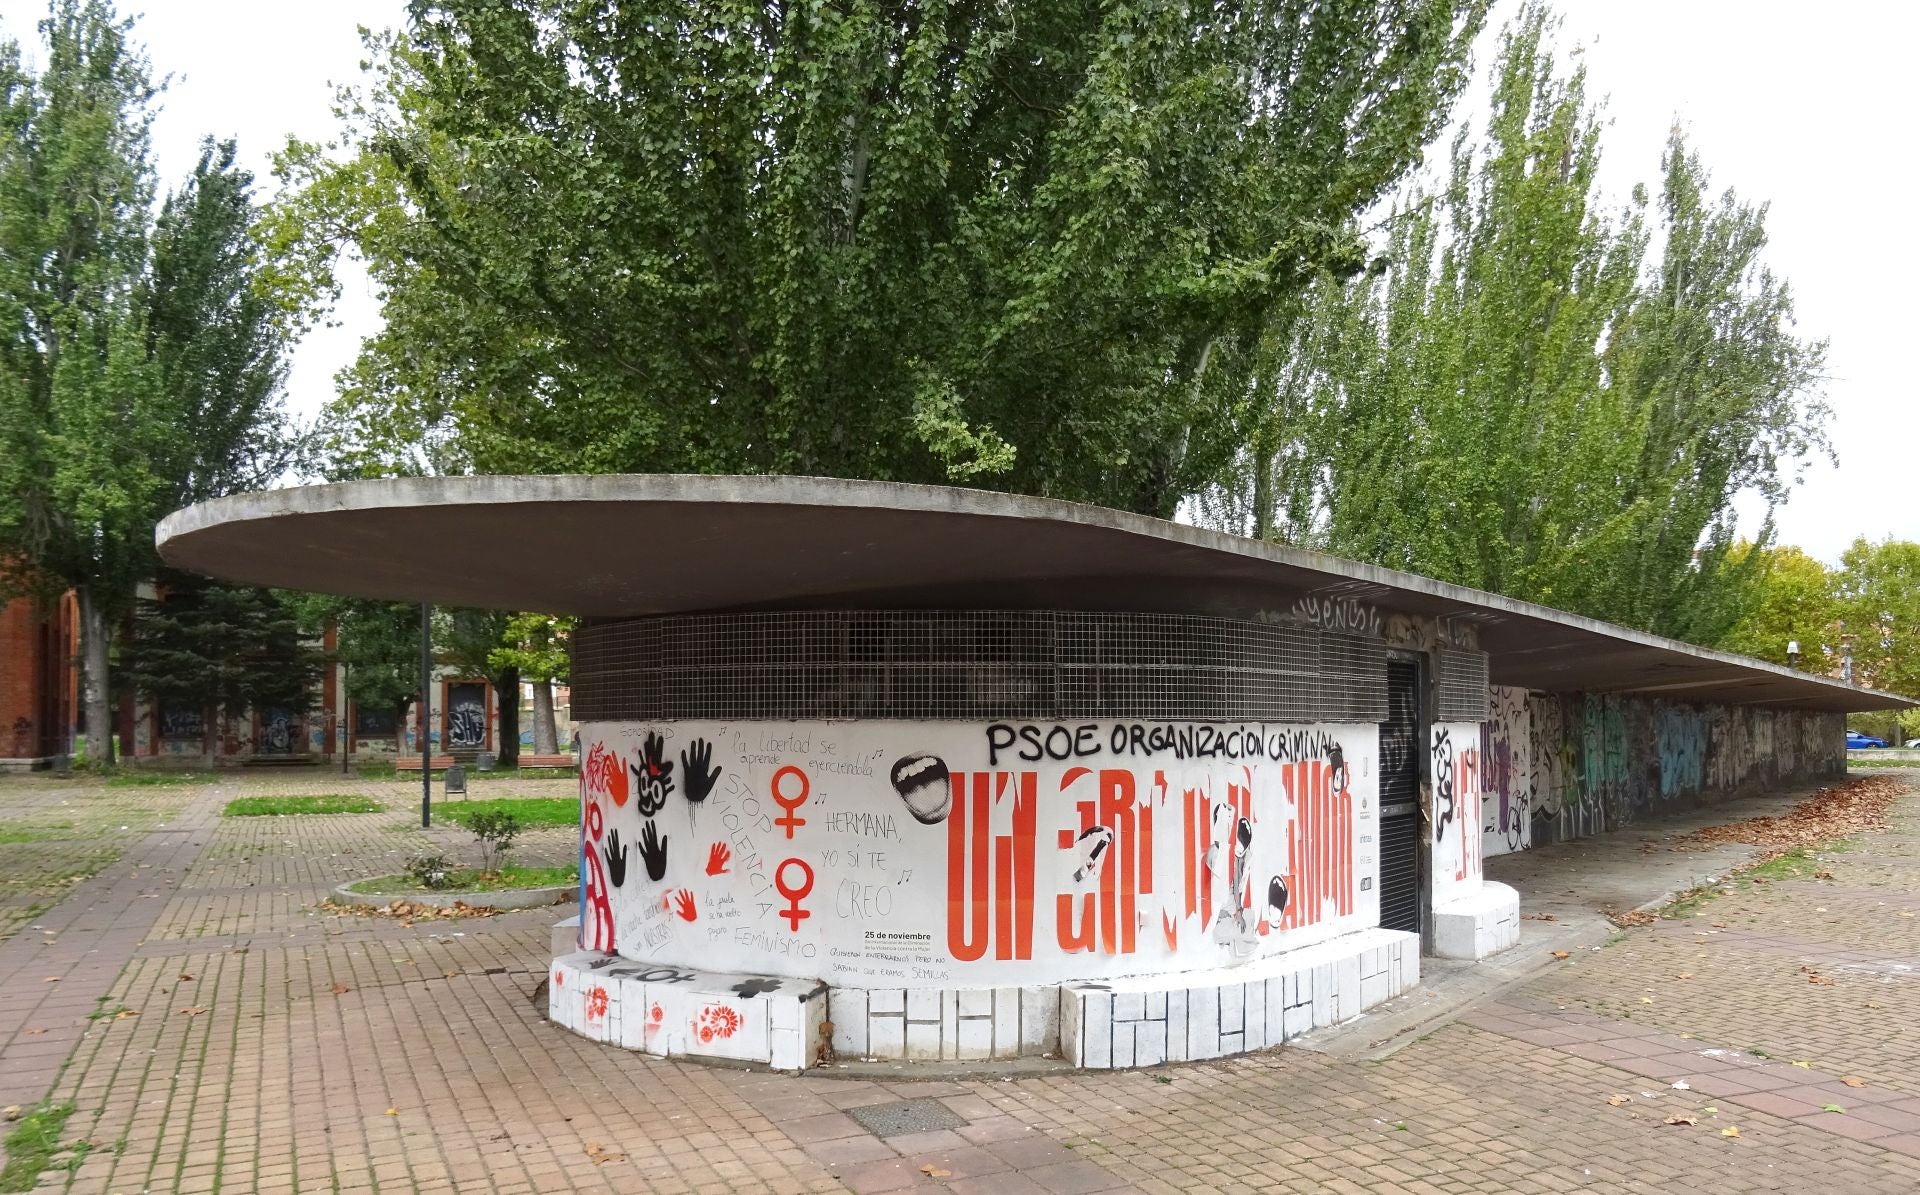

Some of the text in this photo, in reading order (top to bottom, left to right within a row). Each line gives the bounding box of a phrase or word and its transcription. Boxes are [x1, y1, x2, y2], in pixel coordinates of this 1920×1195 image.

[760, 730, 812, 754] libertad
[820, 740, 837, 756] se
[986, 724, 1102, 766] PSOE
[740, 754, 781, 769] aprende
[724, 773, 772, 834] STOP
[824, 812, 902, 843] HERMANA,
[822, 850, 839, 868] YO
[867, 852, 887, 871] TE
[947, 772, 1037, 961] UN
[836, 878, 892, 920] CREO
[864, 931, 931, 940] 25 de noviembre
